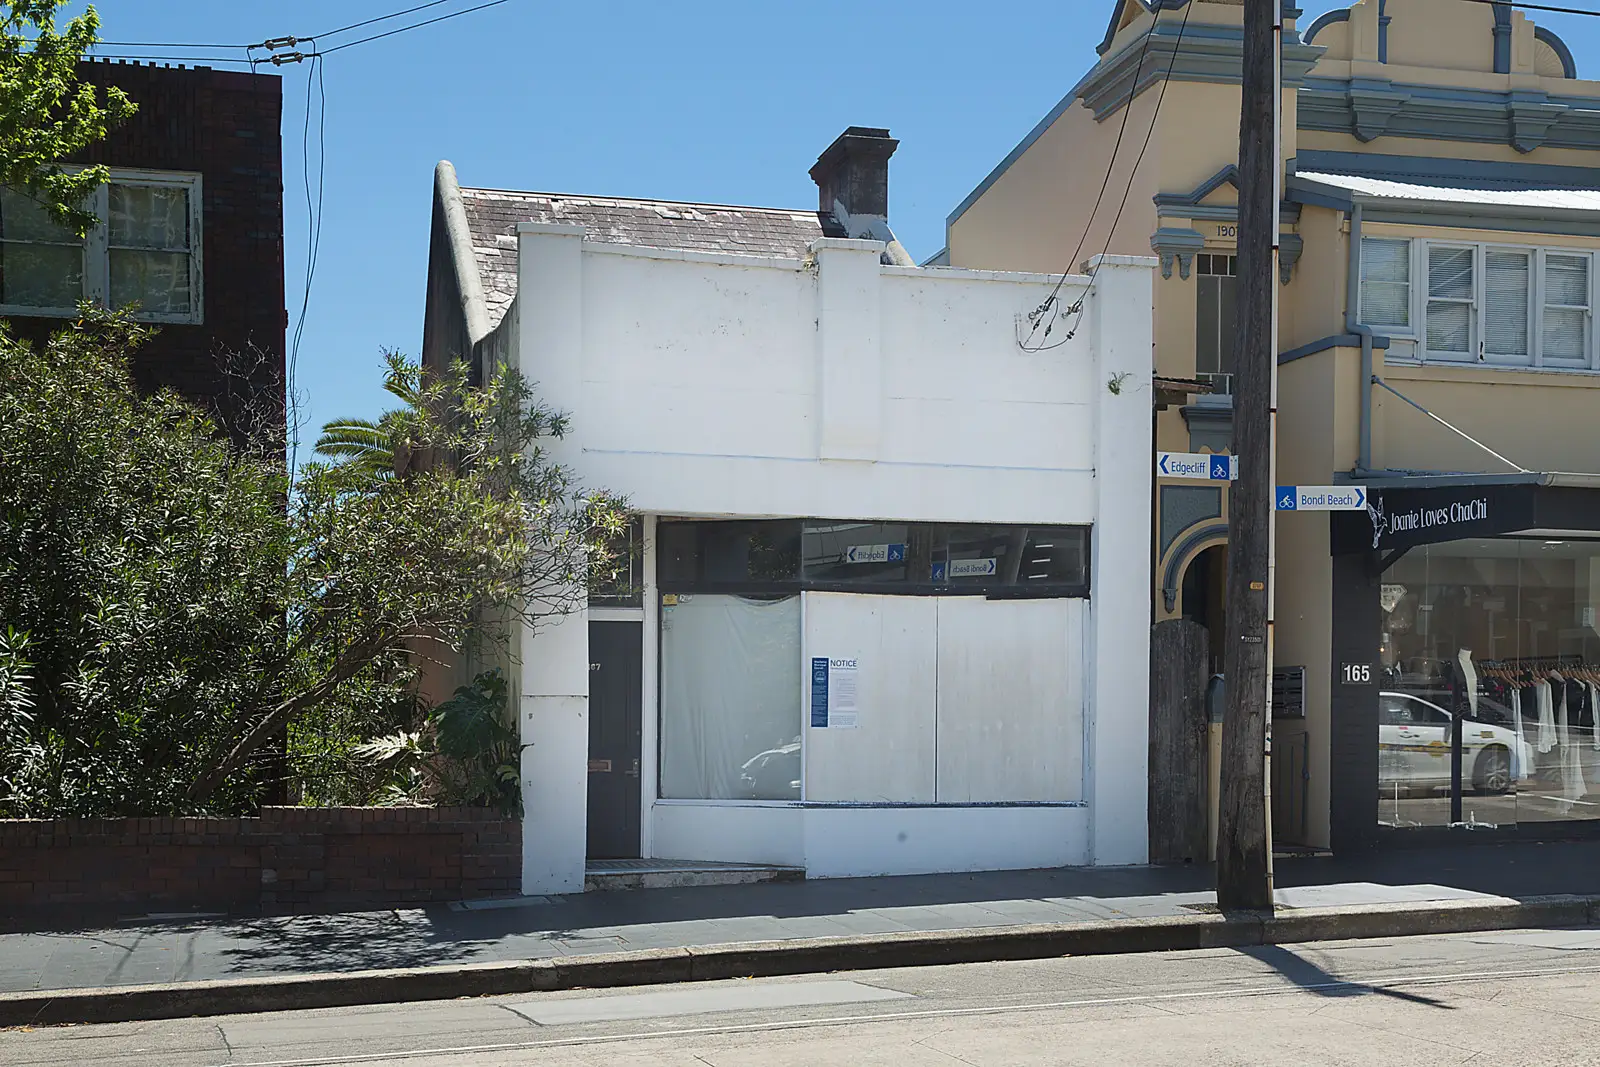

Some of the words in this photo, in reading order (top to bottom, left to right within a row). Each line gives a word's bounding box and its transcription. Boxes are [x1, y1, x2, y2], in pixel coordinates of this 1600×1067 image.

[1217, 225, 1238, 237] 190
[1171, 461, 1206, 474] Edgecliff
[1301, 494, 1326, 506] Bondi
[1327, 495, 1353, 506] Beach
[1389, 510, 1419, 535] Joanie
[1420, 507, 1448, 528] Loves
[1450, 498, 1487, 523] ChaChi
[830, 660, 857, 668] NOTICE
[1343, 664, 1370, 682] 165
